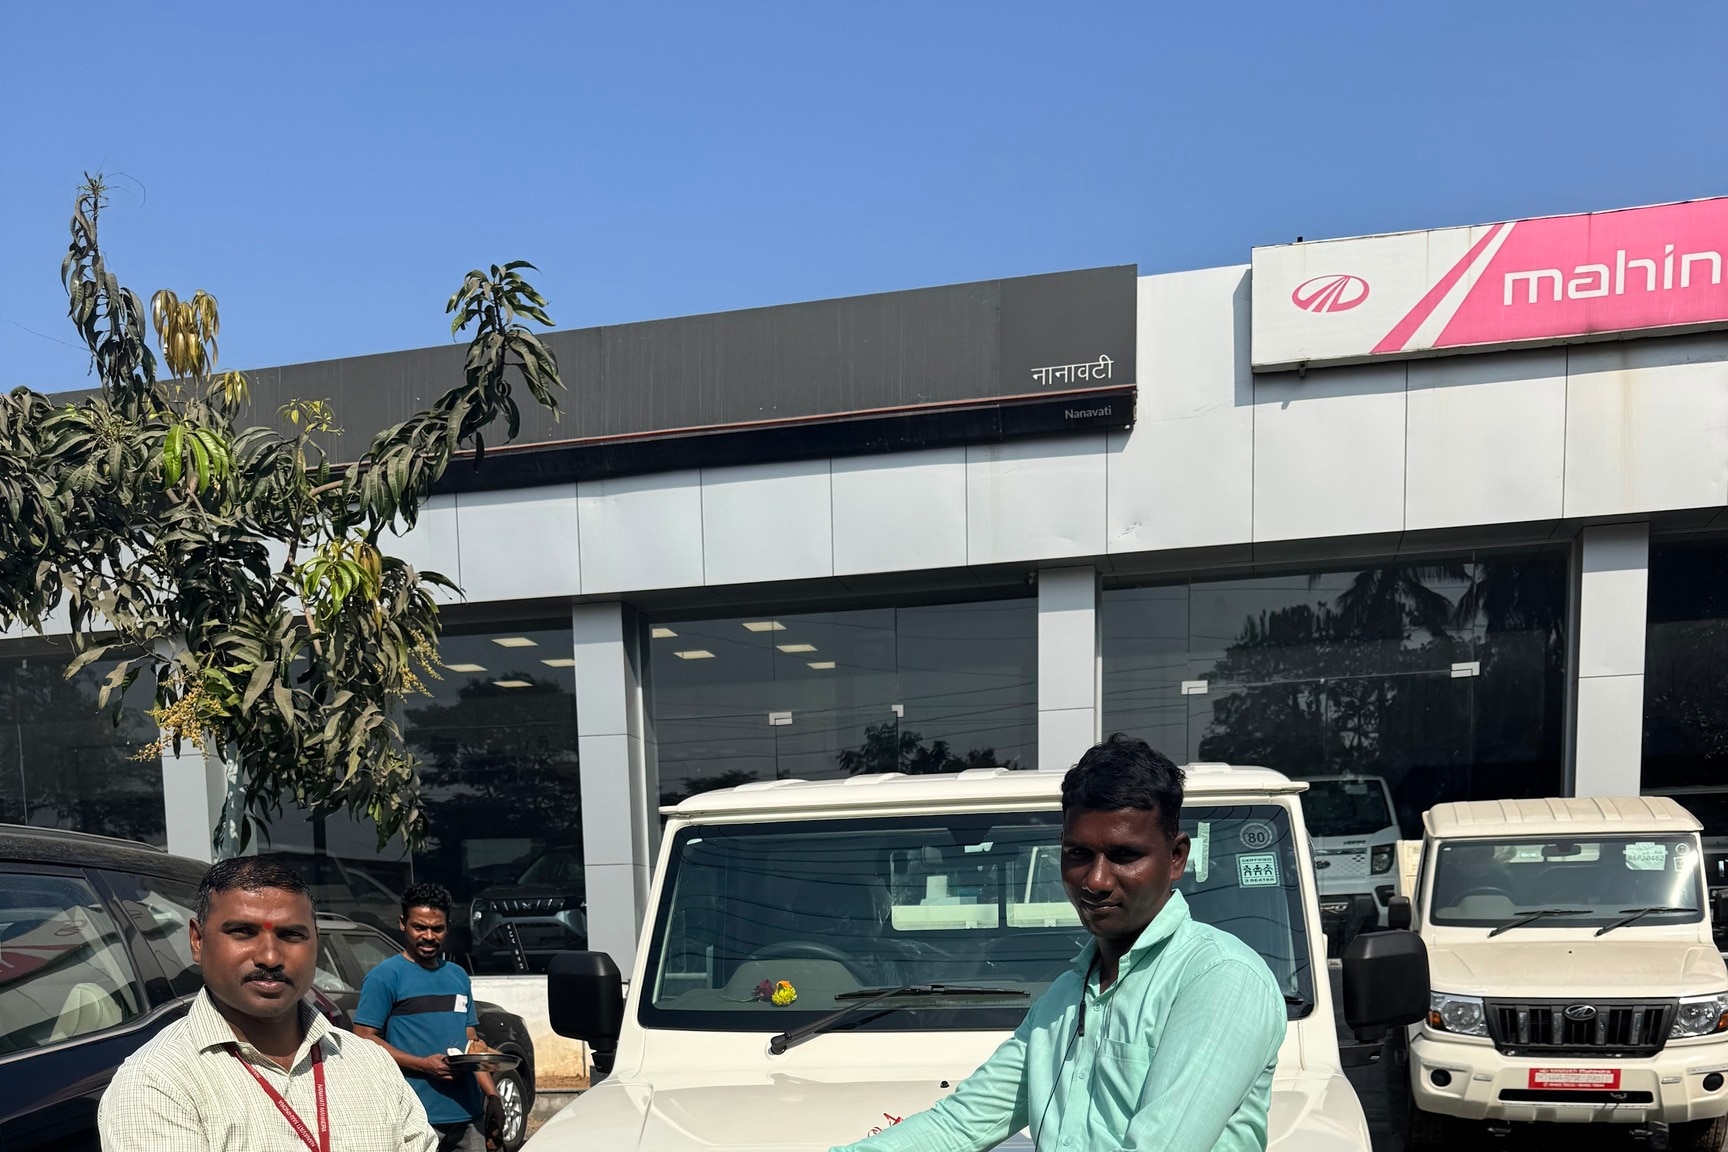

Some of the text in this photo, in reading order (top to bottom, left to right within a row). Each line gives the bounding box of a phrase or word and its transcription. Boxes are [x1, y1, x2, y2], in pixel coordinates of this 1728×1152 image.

[1031, 354, 1114, 385] नानावटी
[1065, 405, 1112, 419] Nanavati
[1248, 832, 1265, 843] 80
